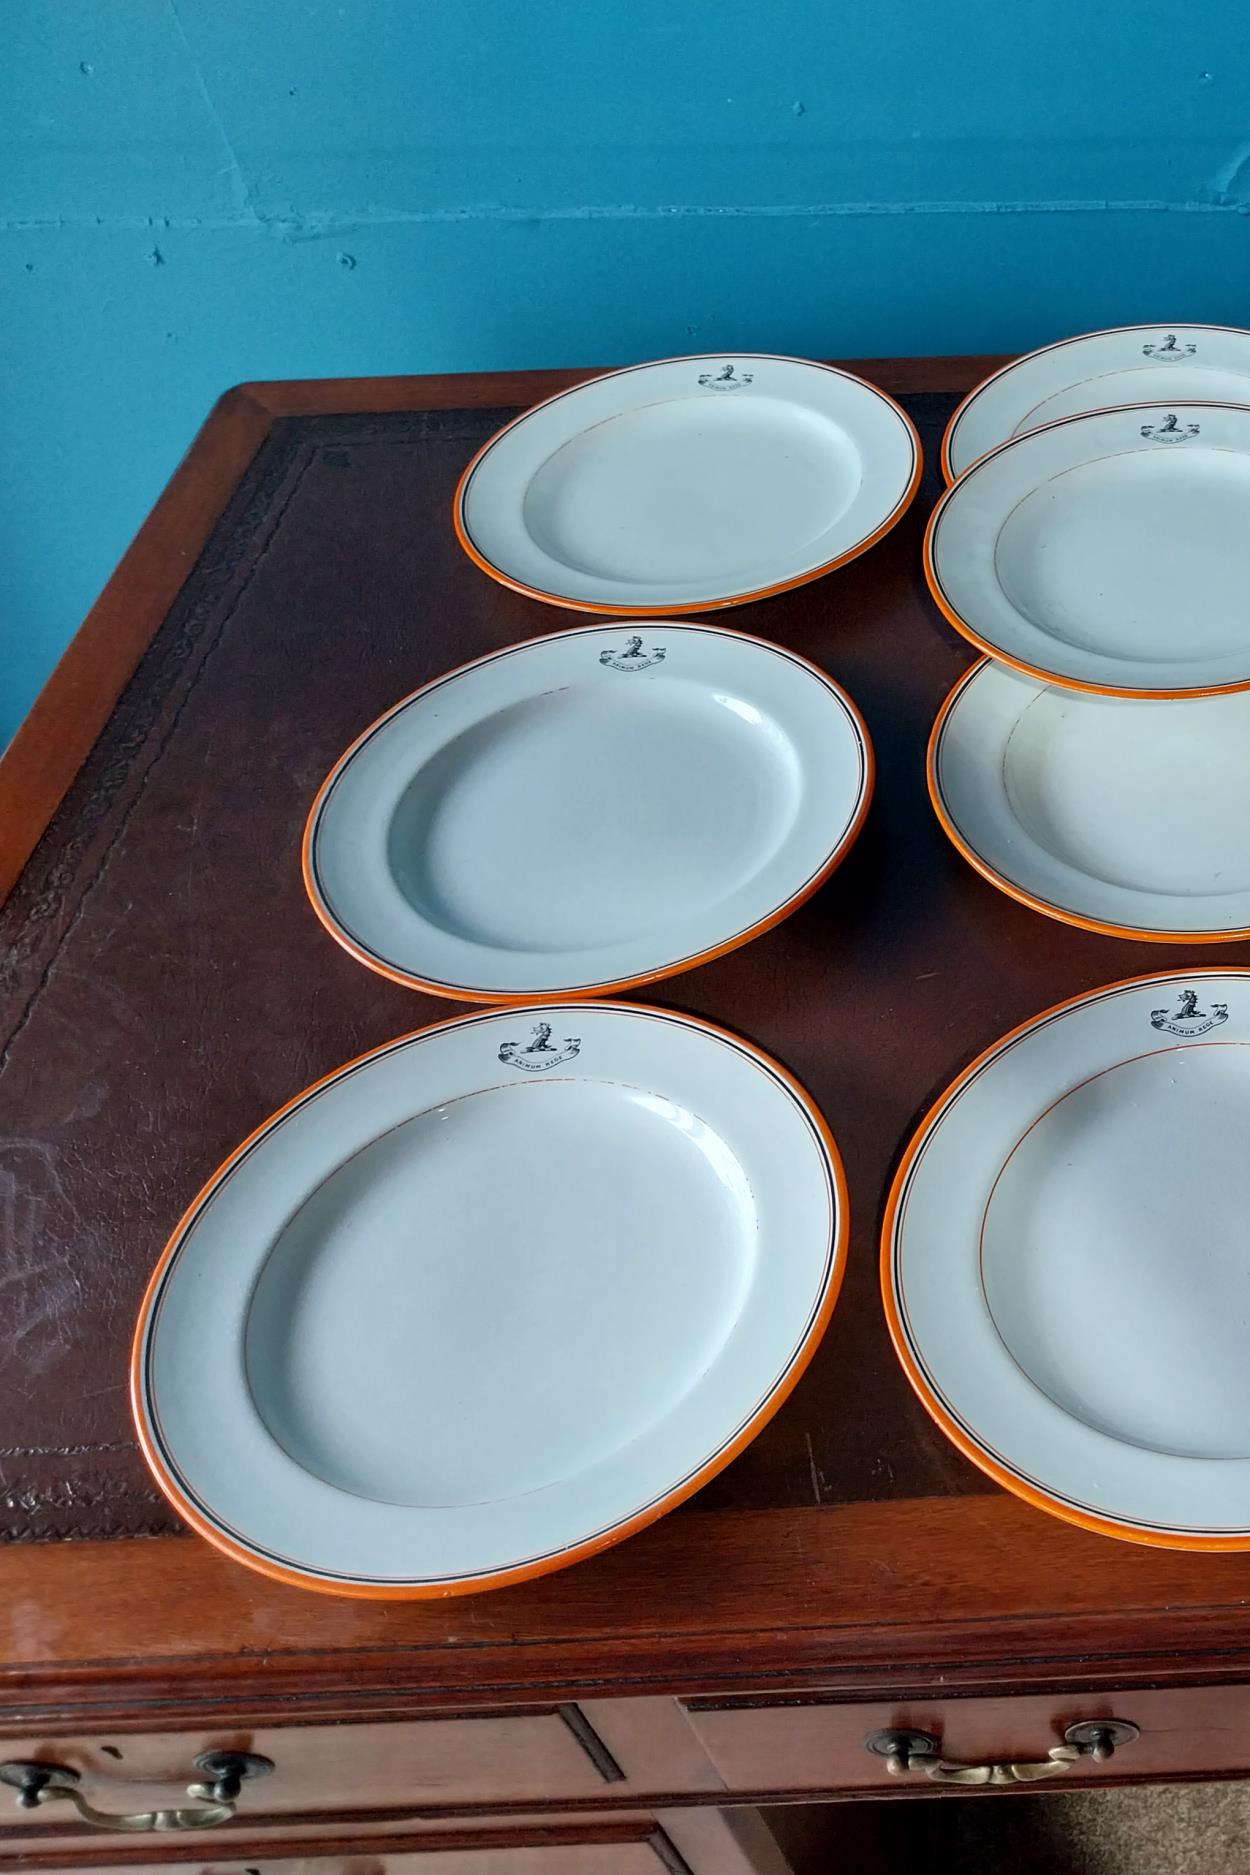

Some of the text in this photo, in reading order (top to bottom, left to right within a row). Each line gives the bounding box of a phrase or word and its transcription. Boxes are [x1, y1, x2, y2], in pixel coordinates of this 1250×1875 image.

[1168, 1021, 1213, 1034] ANIMUM REGE
[514, 1056, 563, 1069] ANIMUM REGE
